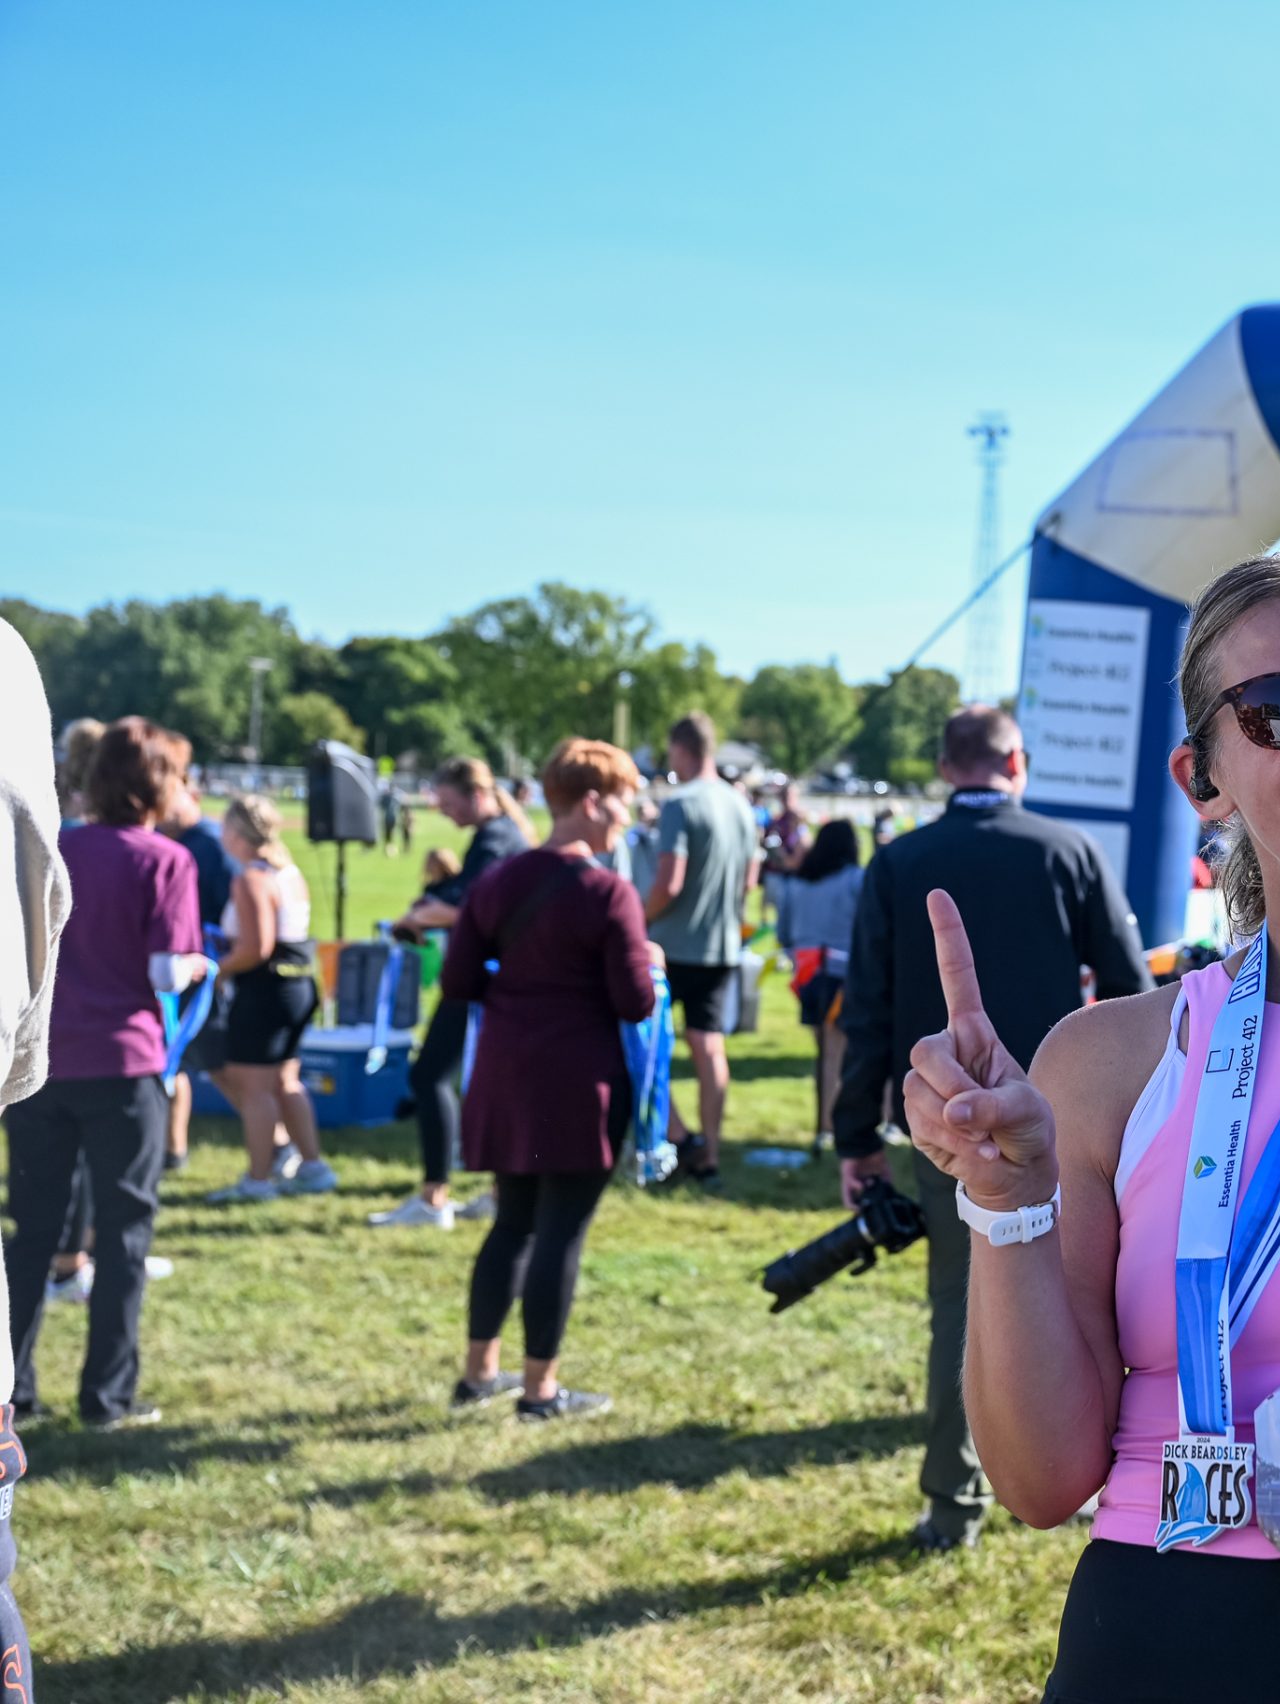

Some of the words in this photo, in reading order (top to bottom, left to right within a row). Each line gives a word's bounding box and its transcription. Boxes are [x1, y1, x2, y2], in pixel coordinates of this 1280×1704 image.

[1242, 1015, 1258, 1042] 412
[1232, 1044, 1255, 1100] Project
[1218, 1160, 1235, 1208] Essentia
[1227, 1119, 1242, 1156] Health
[1164, 1444, 1188, 1459] DICK
[1191, 1445, 1248, 1461] BEARDSLEY
[1160, 1460, 1248, 1526] RACES
